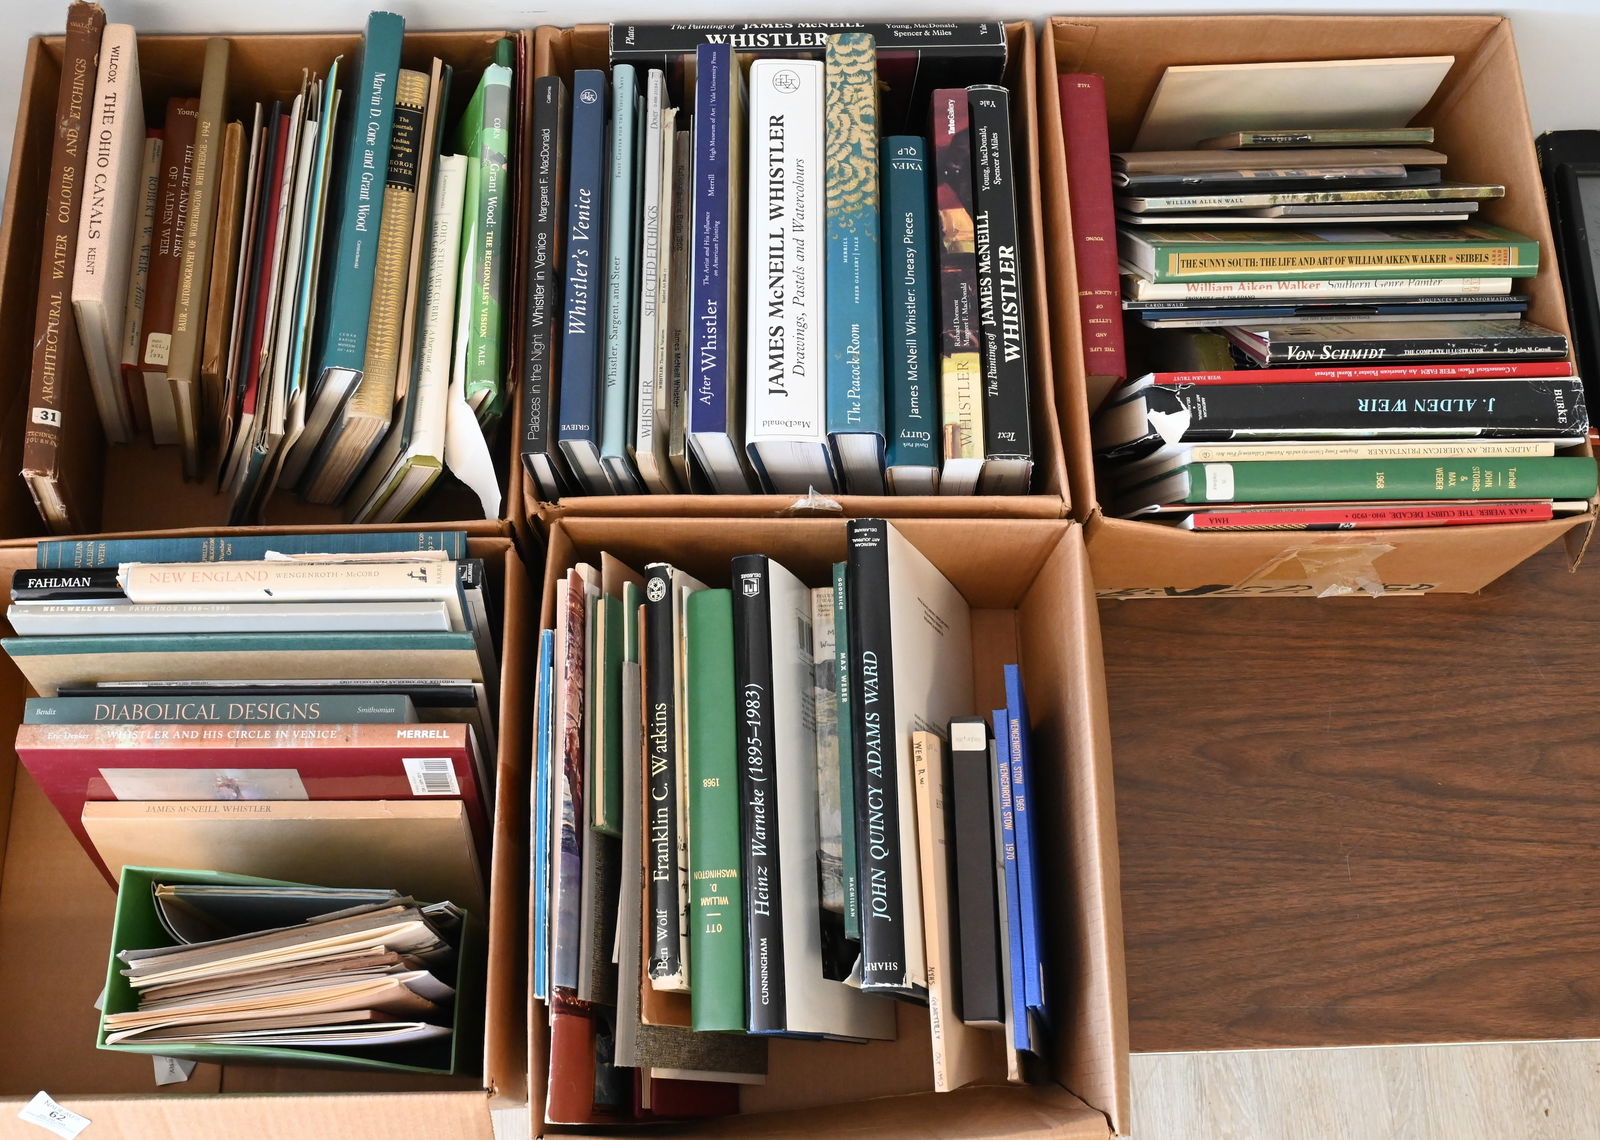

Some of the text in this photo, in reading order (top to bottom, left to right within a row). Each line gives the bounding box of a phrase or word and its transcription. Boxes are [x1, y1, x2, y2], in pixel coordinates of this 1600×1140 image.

[706, 32, 829, 47] WHISTLER
[980, 100, 996, 108] Yale
[86, 45, 120, 275] WILCOX THE OHIO CANALS KENT
[355, 72, 386, 232] Marvin D. Cone and Grant Wood
[42, 58, 87, 405] ARCHITECTURAL WATER COLOURS AND ETCHINGS
[977, 210, 991, 274] McNEILL
[477, 163, 500, 366] Grant Wood: THE REGIONALIST VISION YALE
[569, 188, 591, 334] Whistler's Venice
[768, 114, 788, 397] JAMES McNEILL WHISTLER
[1181, 259, 1197, 268] THE
[1199, 258, 1226, 268] SUNNY
[1227, 258, 1258, 267] SOUTH:
[1260, 257, 1277, 267] THE
[1278, 257, 1298, 266] LIFE
[1299, 256, 1316, 266] AND
[1317, 256, 1334, 266] ART
[1335, 256, 1345, 265] OF
[1346, 255, 1384, 265] WILLIAM
[1385, 255, 1410, 264] AIKEN
[1412, 254, 1446, 264] WALKER
[1456, 254, 1489, 263] SEIBELS
[792, 158, 808, 377] Drawings, Pastels and Watercolours
[528, 128, 551, 440] Palaces in the Night Whistler in Venice Margaret F. MacDonald
[980, 276, 996, 327] JAMES
[999, 245, 1021, 362] WHISTLER
[904, 212, 920, 418] James McNeill Whistler: Uneasy Pieces
[699, 299, 717, 405] After Whistler
[986, 340, 998, 381] Paintings
[1288, 345, 1386, 360] VON SCHMIDT
[847, 324, 861, 424] The Peacock Room
[989, 383, 999, 396] The
[957, 361, 972, 446] WHISTLER
[1358, 398, 1496, 413] J. ALDEN WEIR
[1553, 389, 1568, 424] BURKE
[40, 411, 56, 422] 31
[762, 420, 811, 428] MacDonald
[998, 431, 1016, 442] Text
[1480, 446, 1503, 454] WEIR,
[1533, 444, 1539, 452] J.
[1376, 472, 1384, 489] 1968
[1472, 466, 1480, 492] STORRS
[1485, 470, 1493, 488] JOHN
[28, 577, 91, 588] FAHLMAN
[150, 571, 186, 583] NEW
[192, 570, 269, 583] ENGLAND
[276, 571, 338, 579] WENGENROTH
[95, 704, 220, 721] DIABOLICAL
[229, 703, 320, 720] DESIGNS
[107, 731, 169, 739] WHISTLER
[173, 731, 199, 739] AND
[203, 731, 223, 739] HIS
[227, 730, 271, 739] CIRCLE
[276, 730, 290, 738] IN
[294, 730, 337, 738] VENICE
[397, 730, 449, 738] MERRELL
[1011, 719, 1024, 811] WENGENROTH, STOW 1969
[703, 778, 720, 787] 1968
[863, 650, 891, 921] JOHN QUINCY ADAMS WARD
[223, 805, 272, 813] WHISTLER
[1000, 762, 1014, 860] WENGENROTH, STOW 1970
[750, 789, 767, 857] Warneke
[651, 703, 669, 970] Ben Wolf Franklin C. Watkins
[693, 868, 737, 880] WASHINGTON
[710, 884, 717, 892] D.
[754, 866, 770, 917] Heinz
[701, 896, 728, 906] WILLIAM
[705, 924, 722, 934] OTT
[865, 962, 898, 971] SHARP
[49, 1111, 66, 1121] 62
